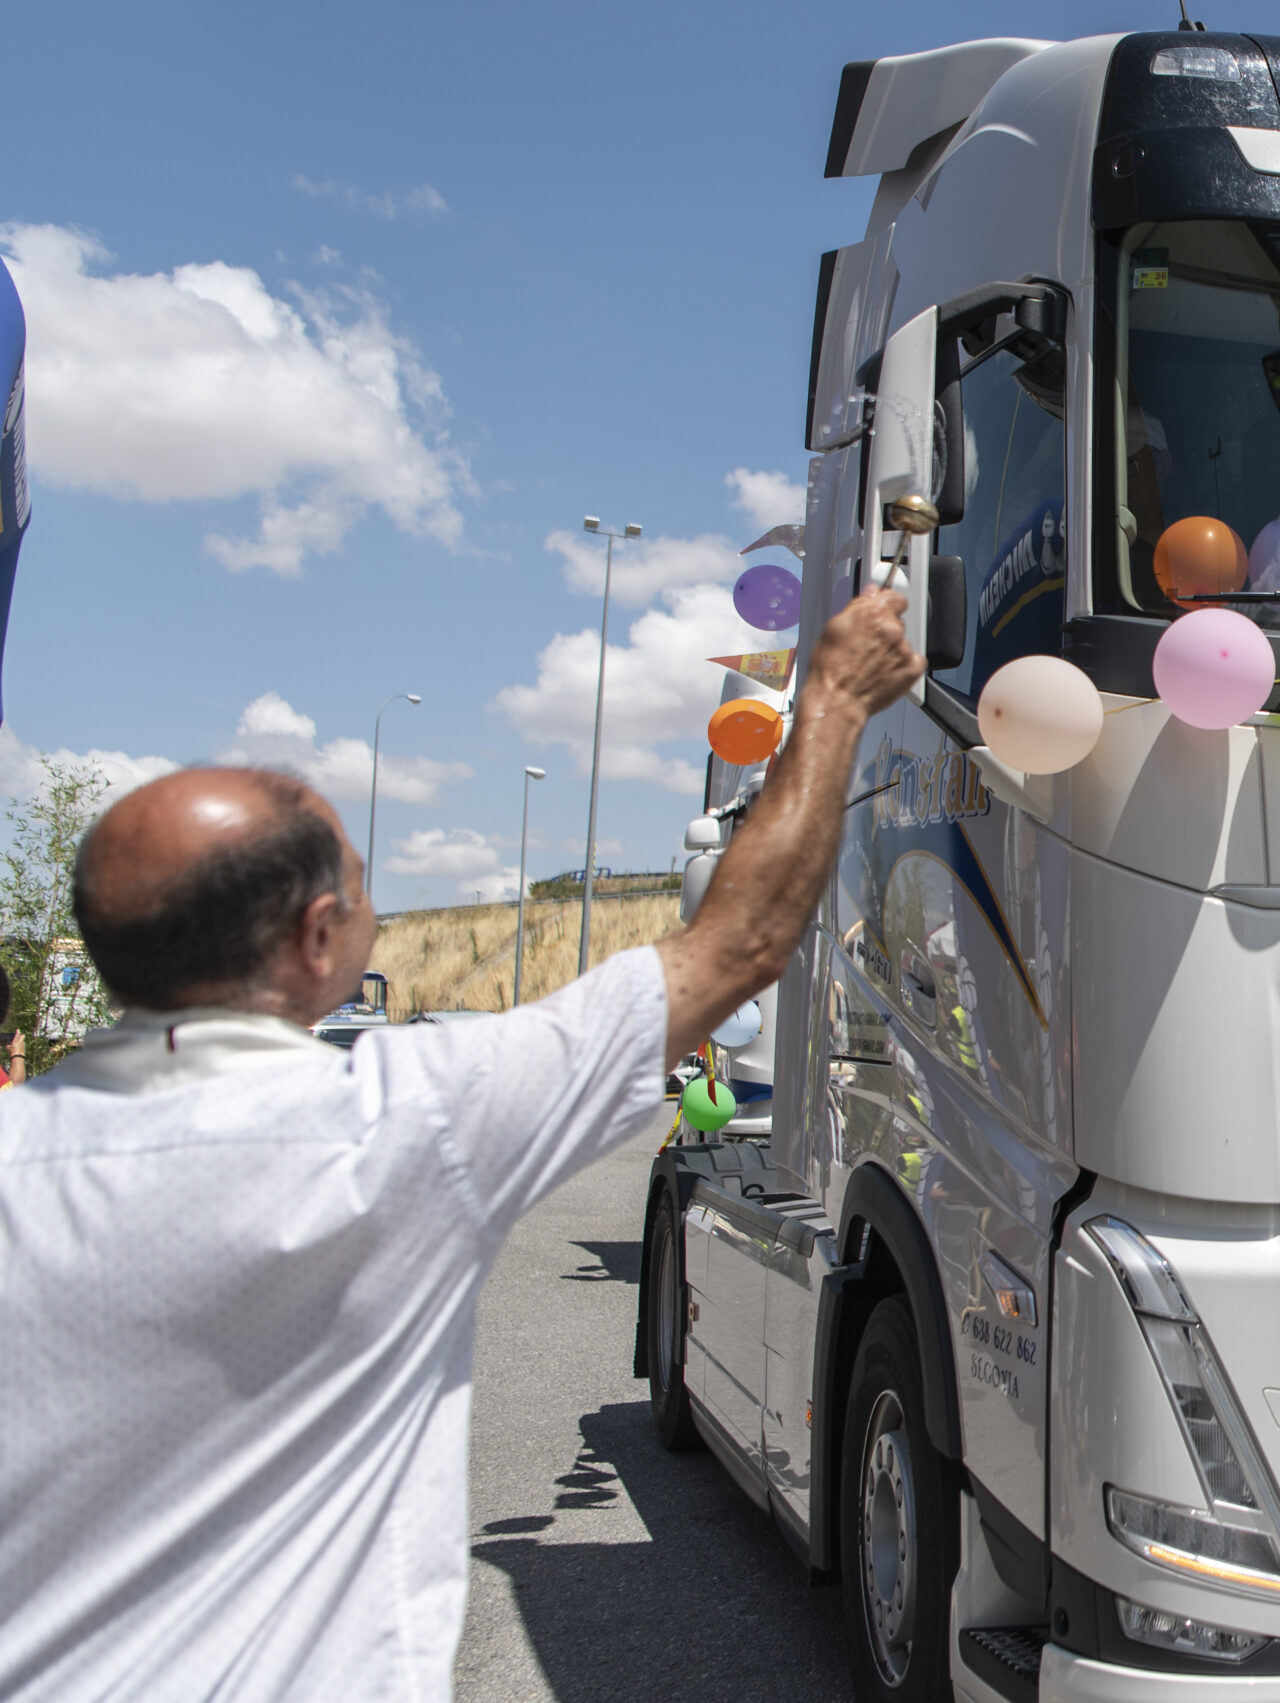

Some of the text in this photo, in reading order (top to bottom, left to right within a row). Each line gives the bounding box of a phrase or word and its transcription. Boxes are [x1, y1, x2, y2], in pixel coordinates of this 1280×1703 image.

[871, 732, 991, 842] Konstan
[973, 1316, 1036, 1366] 638 622 862
[971, 1353, 1019, 1399] SEGOVIA
